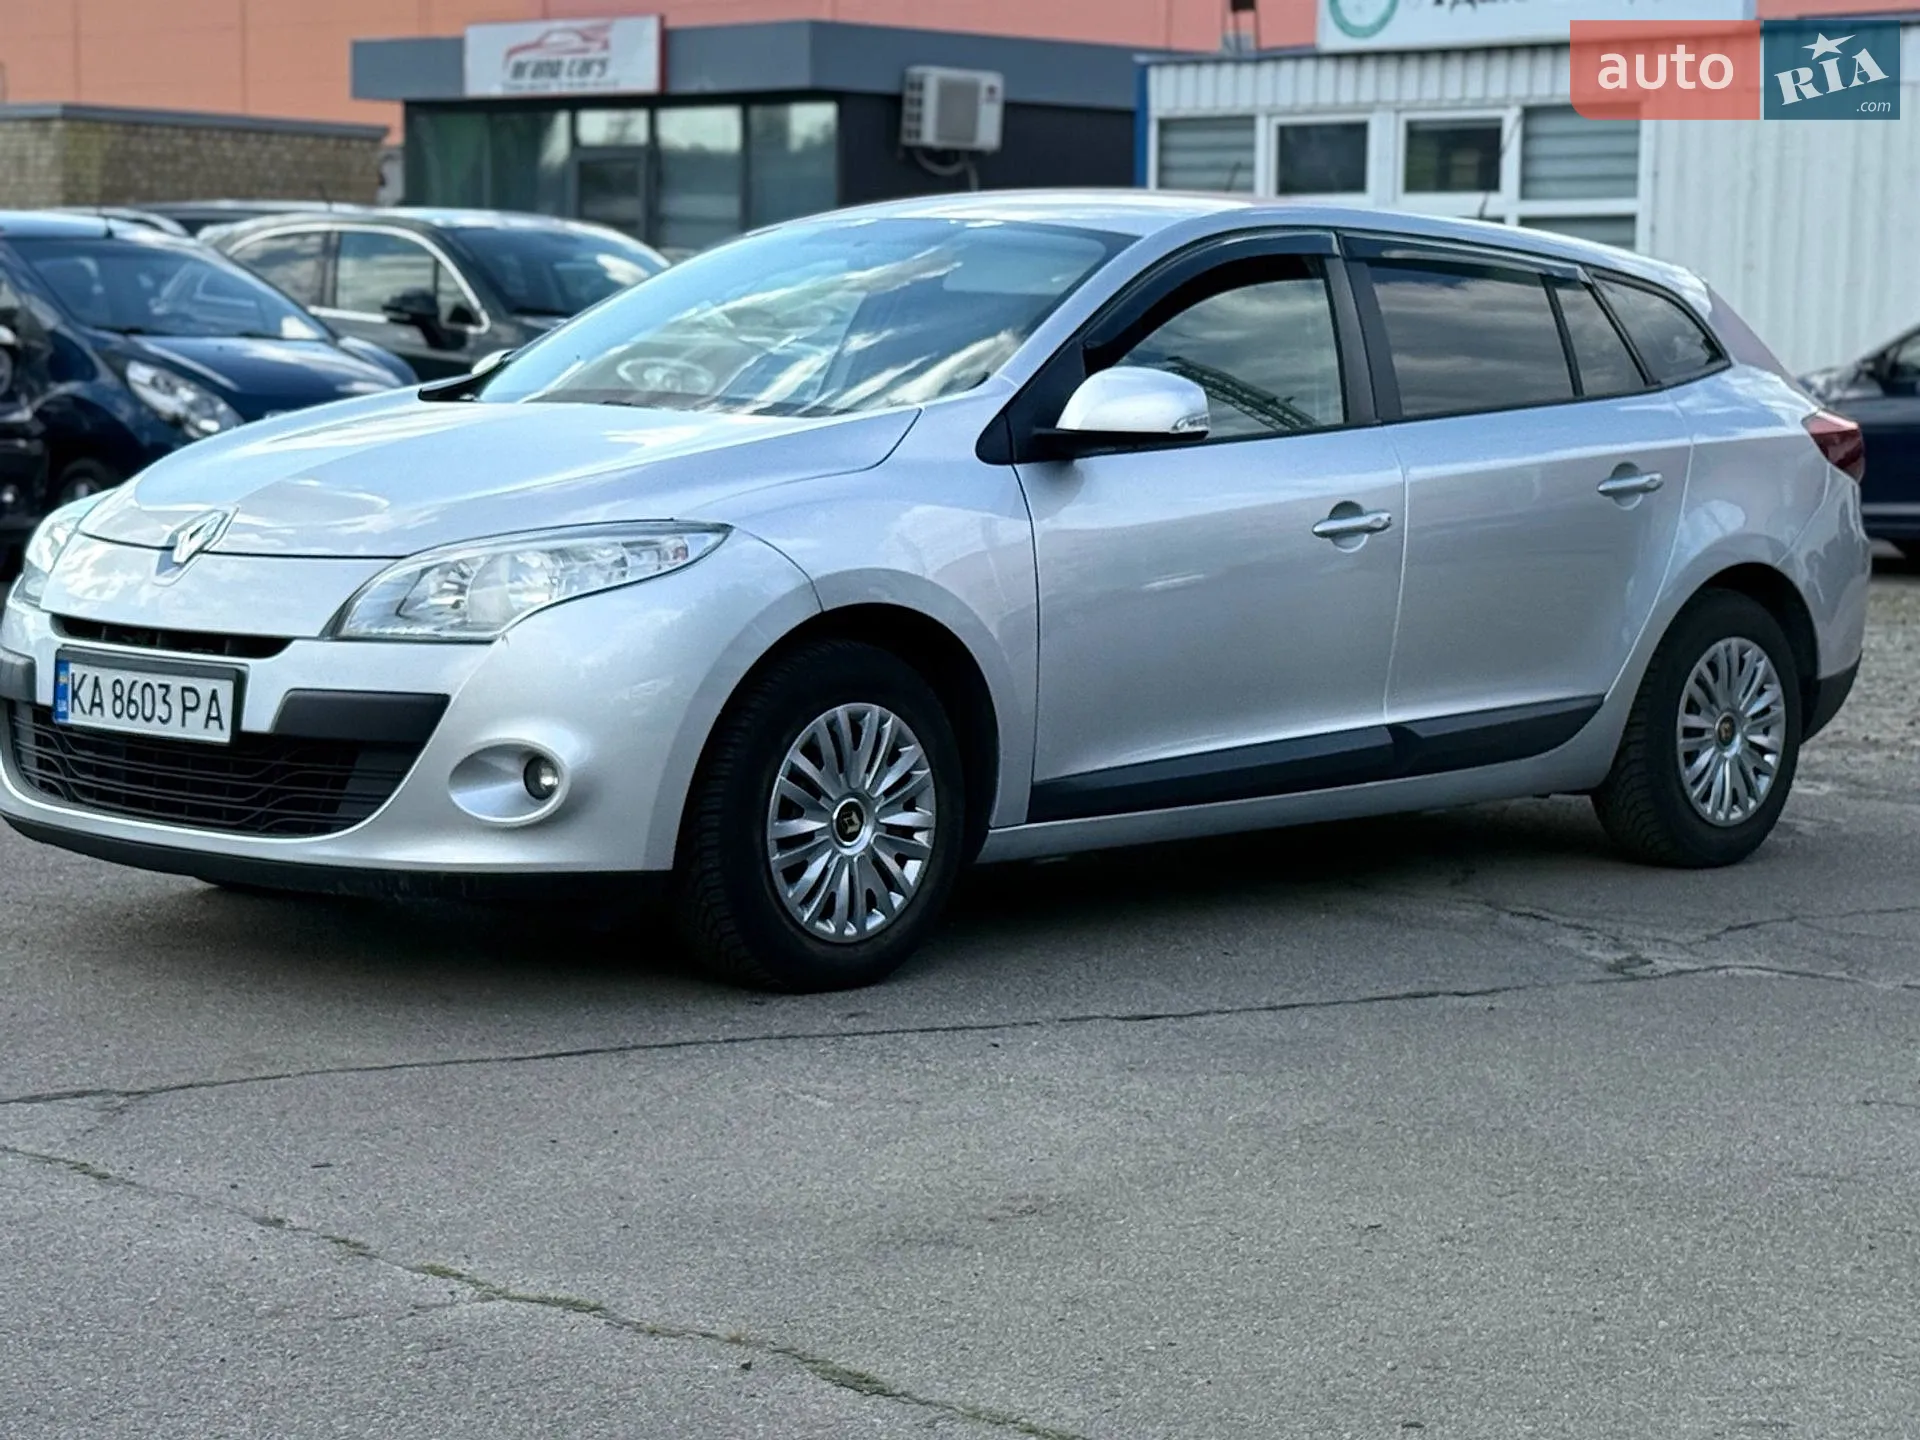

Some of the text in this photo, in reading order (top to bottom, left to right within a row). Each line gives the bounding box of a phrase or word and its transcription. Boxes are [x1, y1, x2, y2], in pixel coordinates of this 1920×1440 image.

[71, 672, 224, 731] KA 8603 PA
